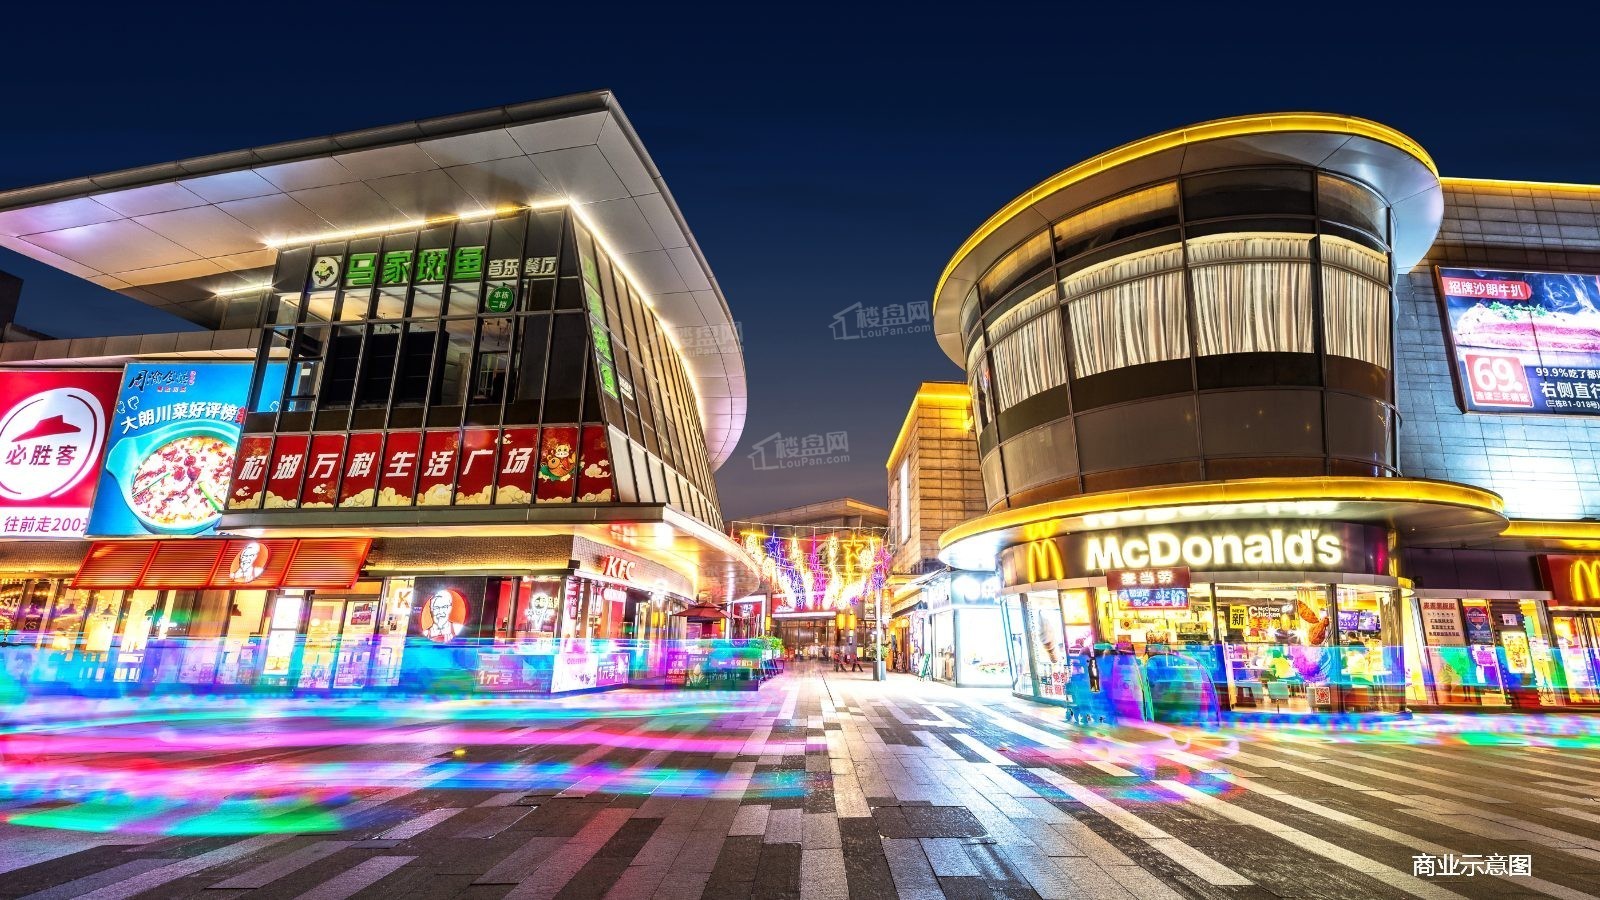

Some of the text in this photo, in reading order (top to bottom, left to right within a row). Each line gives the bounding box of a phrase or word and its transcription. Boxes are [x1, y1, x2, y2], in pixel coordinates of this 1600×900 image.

[346, 246, 556, 286] 马家斑鱼 音乐餐厅
[1448, 281, 1524, 297] 招牌沙朗牛扒
[5, 444, 77, 466] 必胜客
[238, 447, 535, 481] 松湖万科生活广场
[1086, 529, 1342, 570] McDonald's
[605, 554, 636, 581] KFC
[1232, 613, 1245, 626] 新
